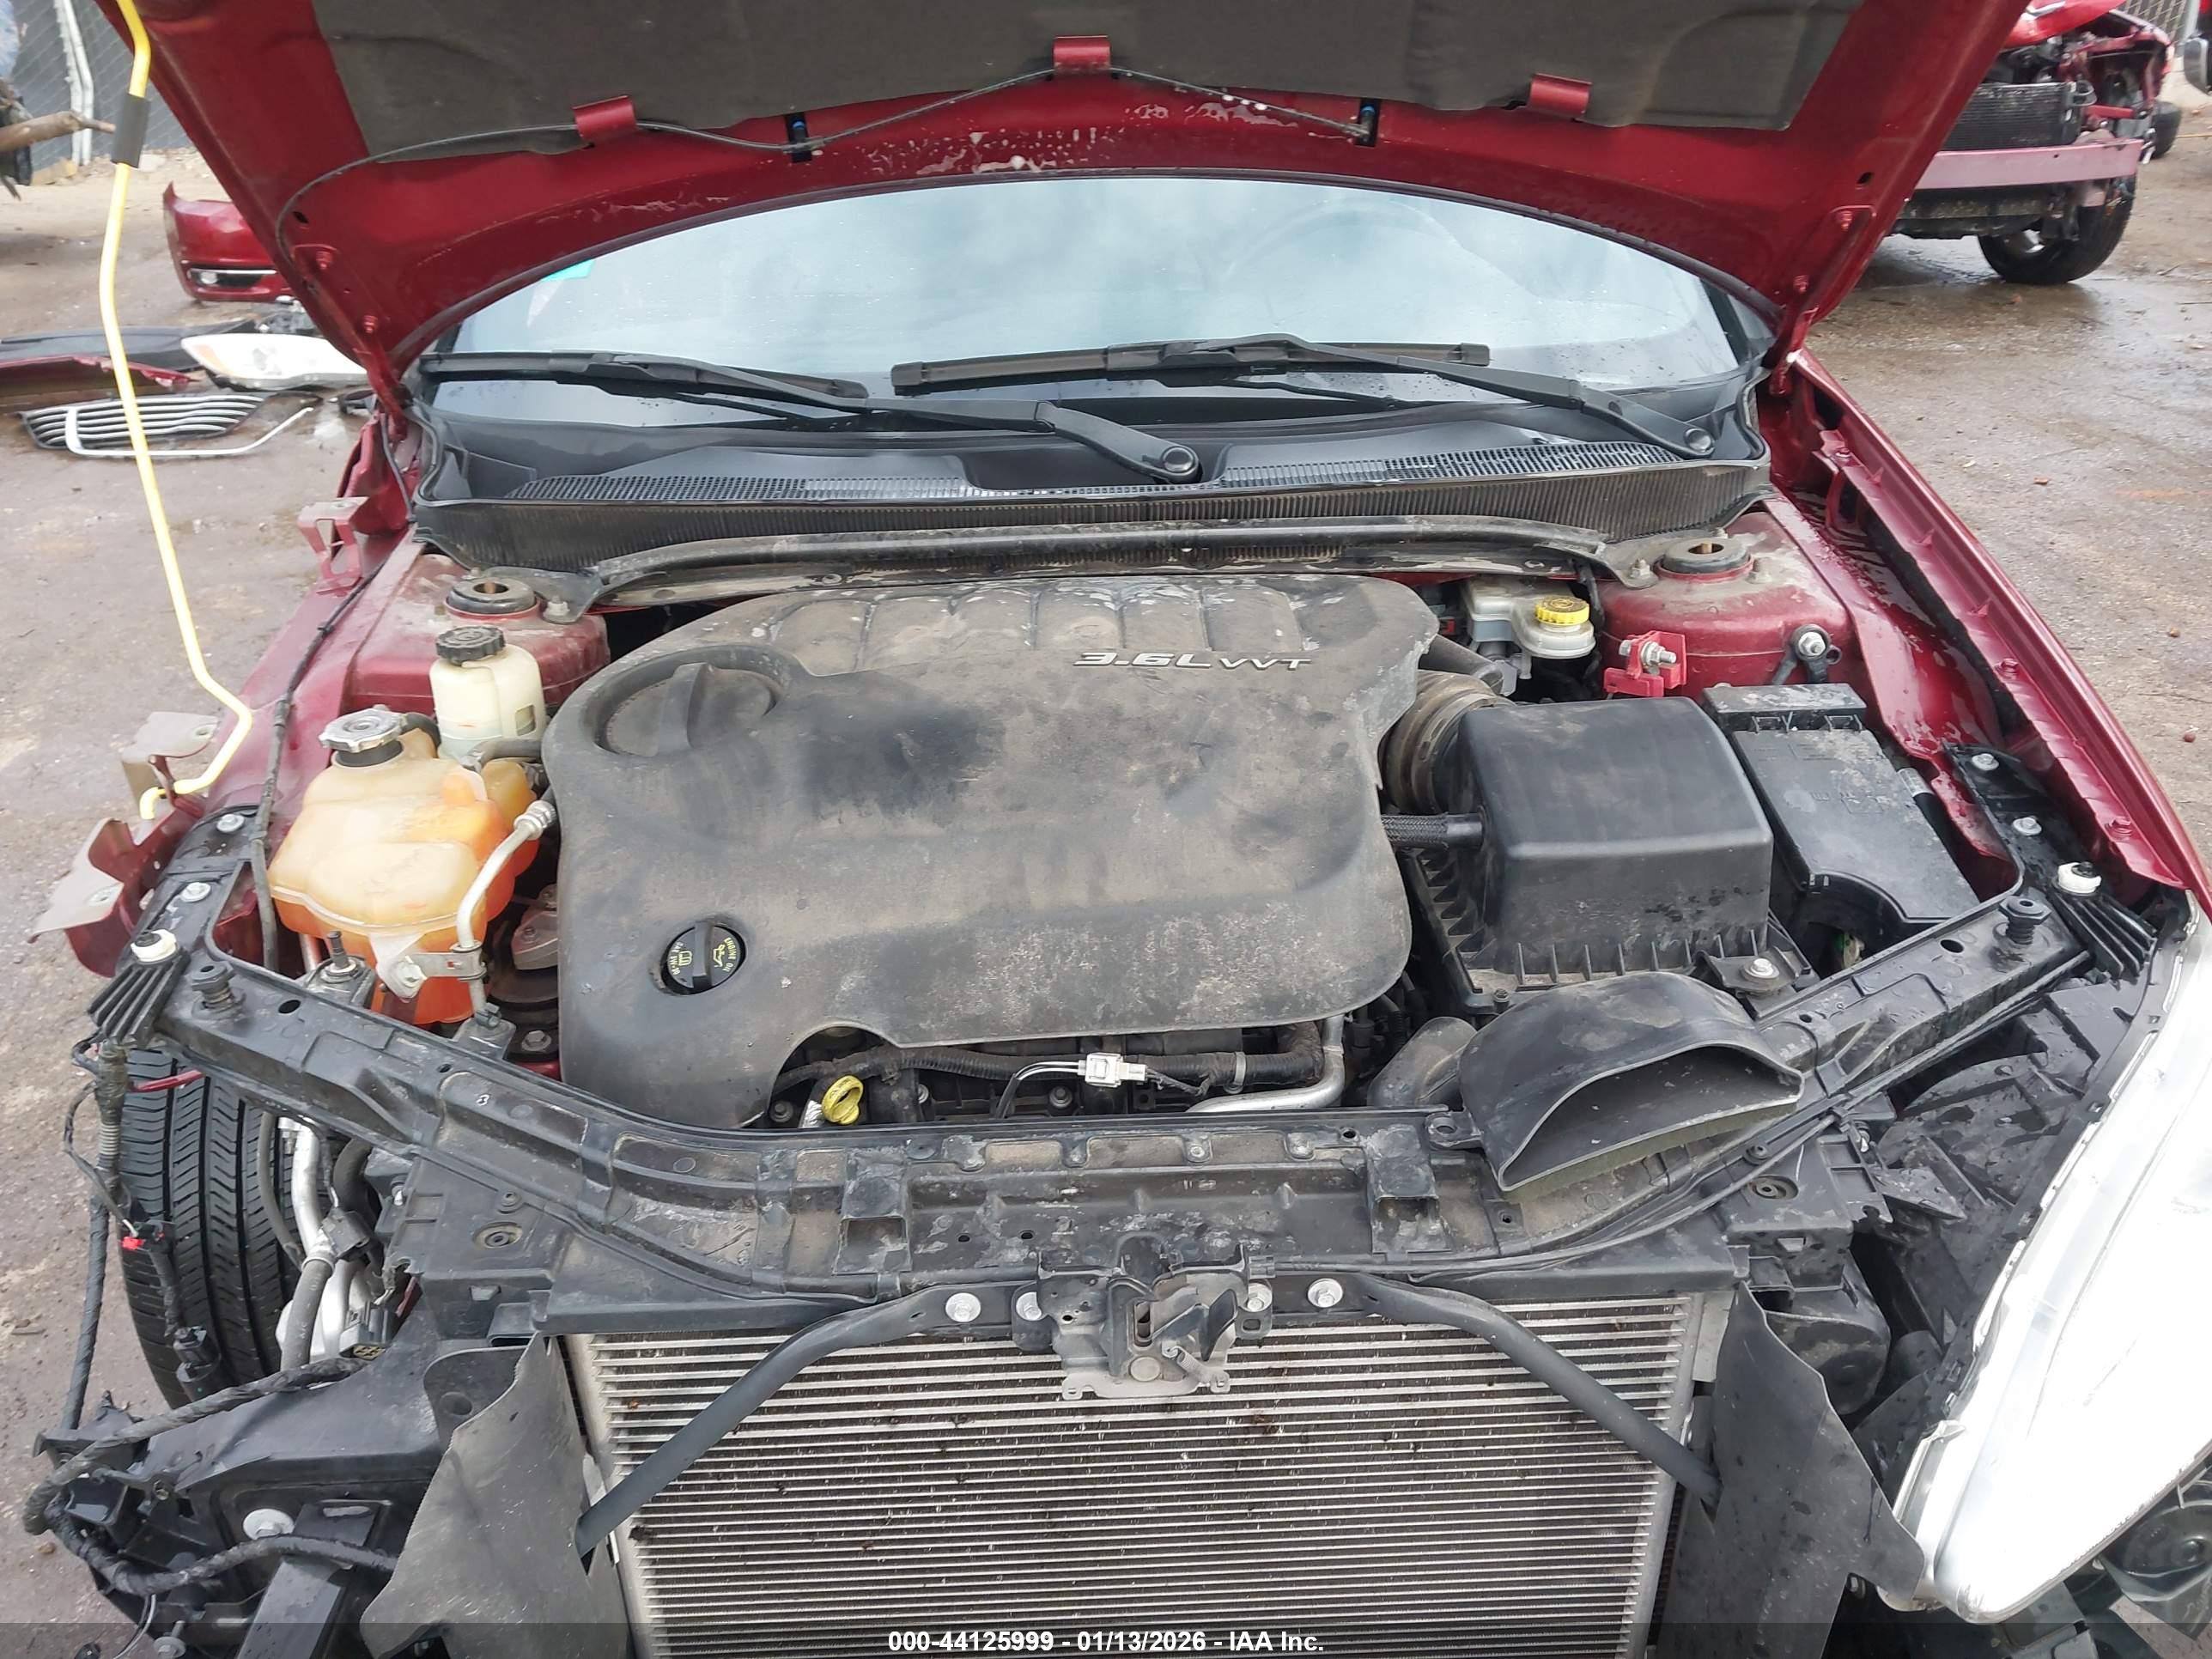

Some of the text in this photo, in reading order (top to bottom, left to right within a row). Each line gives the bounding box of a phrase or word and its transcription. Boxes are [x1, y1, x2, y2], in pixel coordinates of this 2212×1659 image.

[1073, 652, 1312, 671] 3.6L VVT
[721, 937, 737, 972] ENGINE OIL
